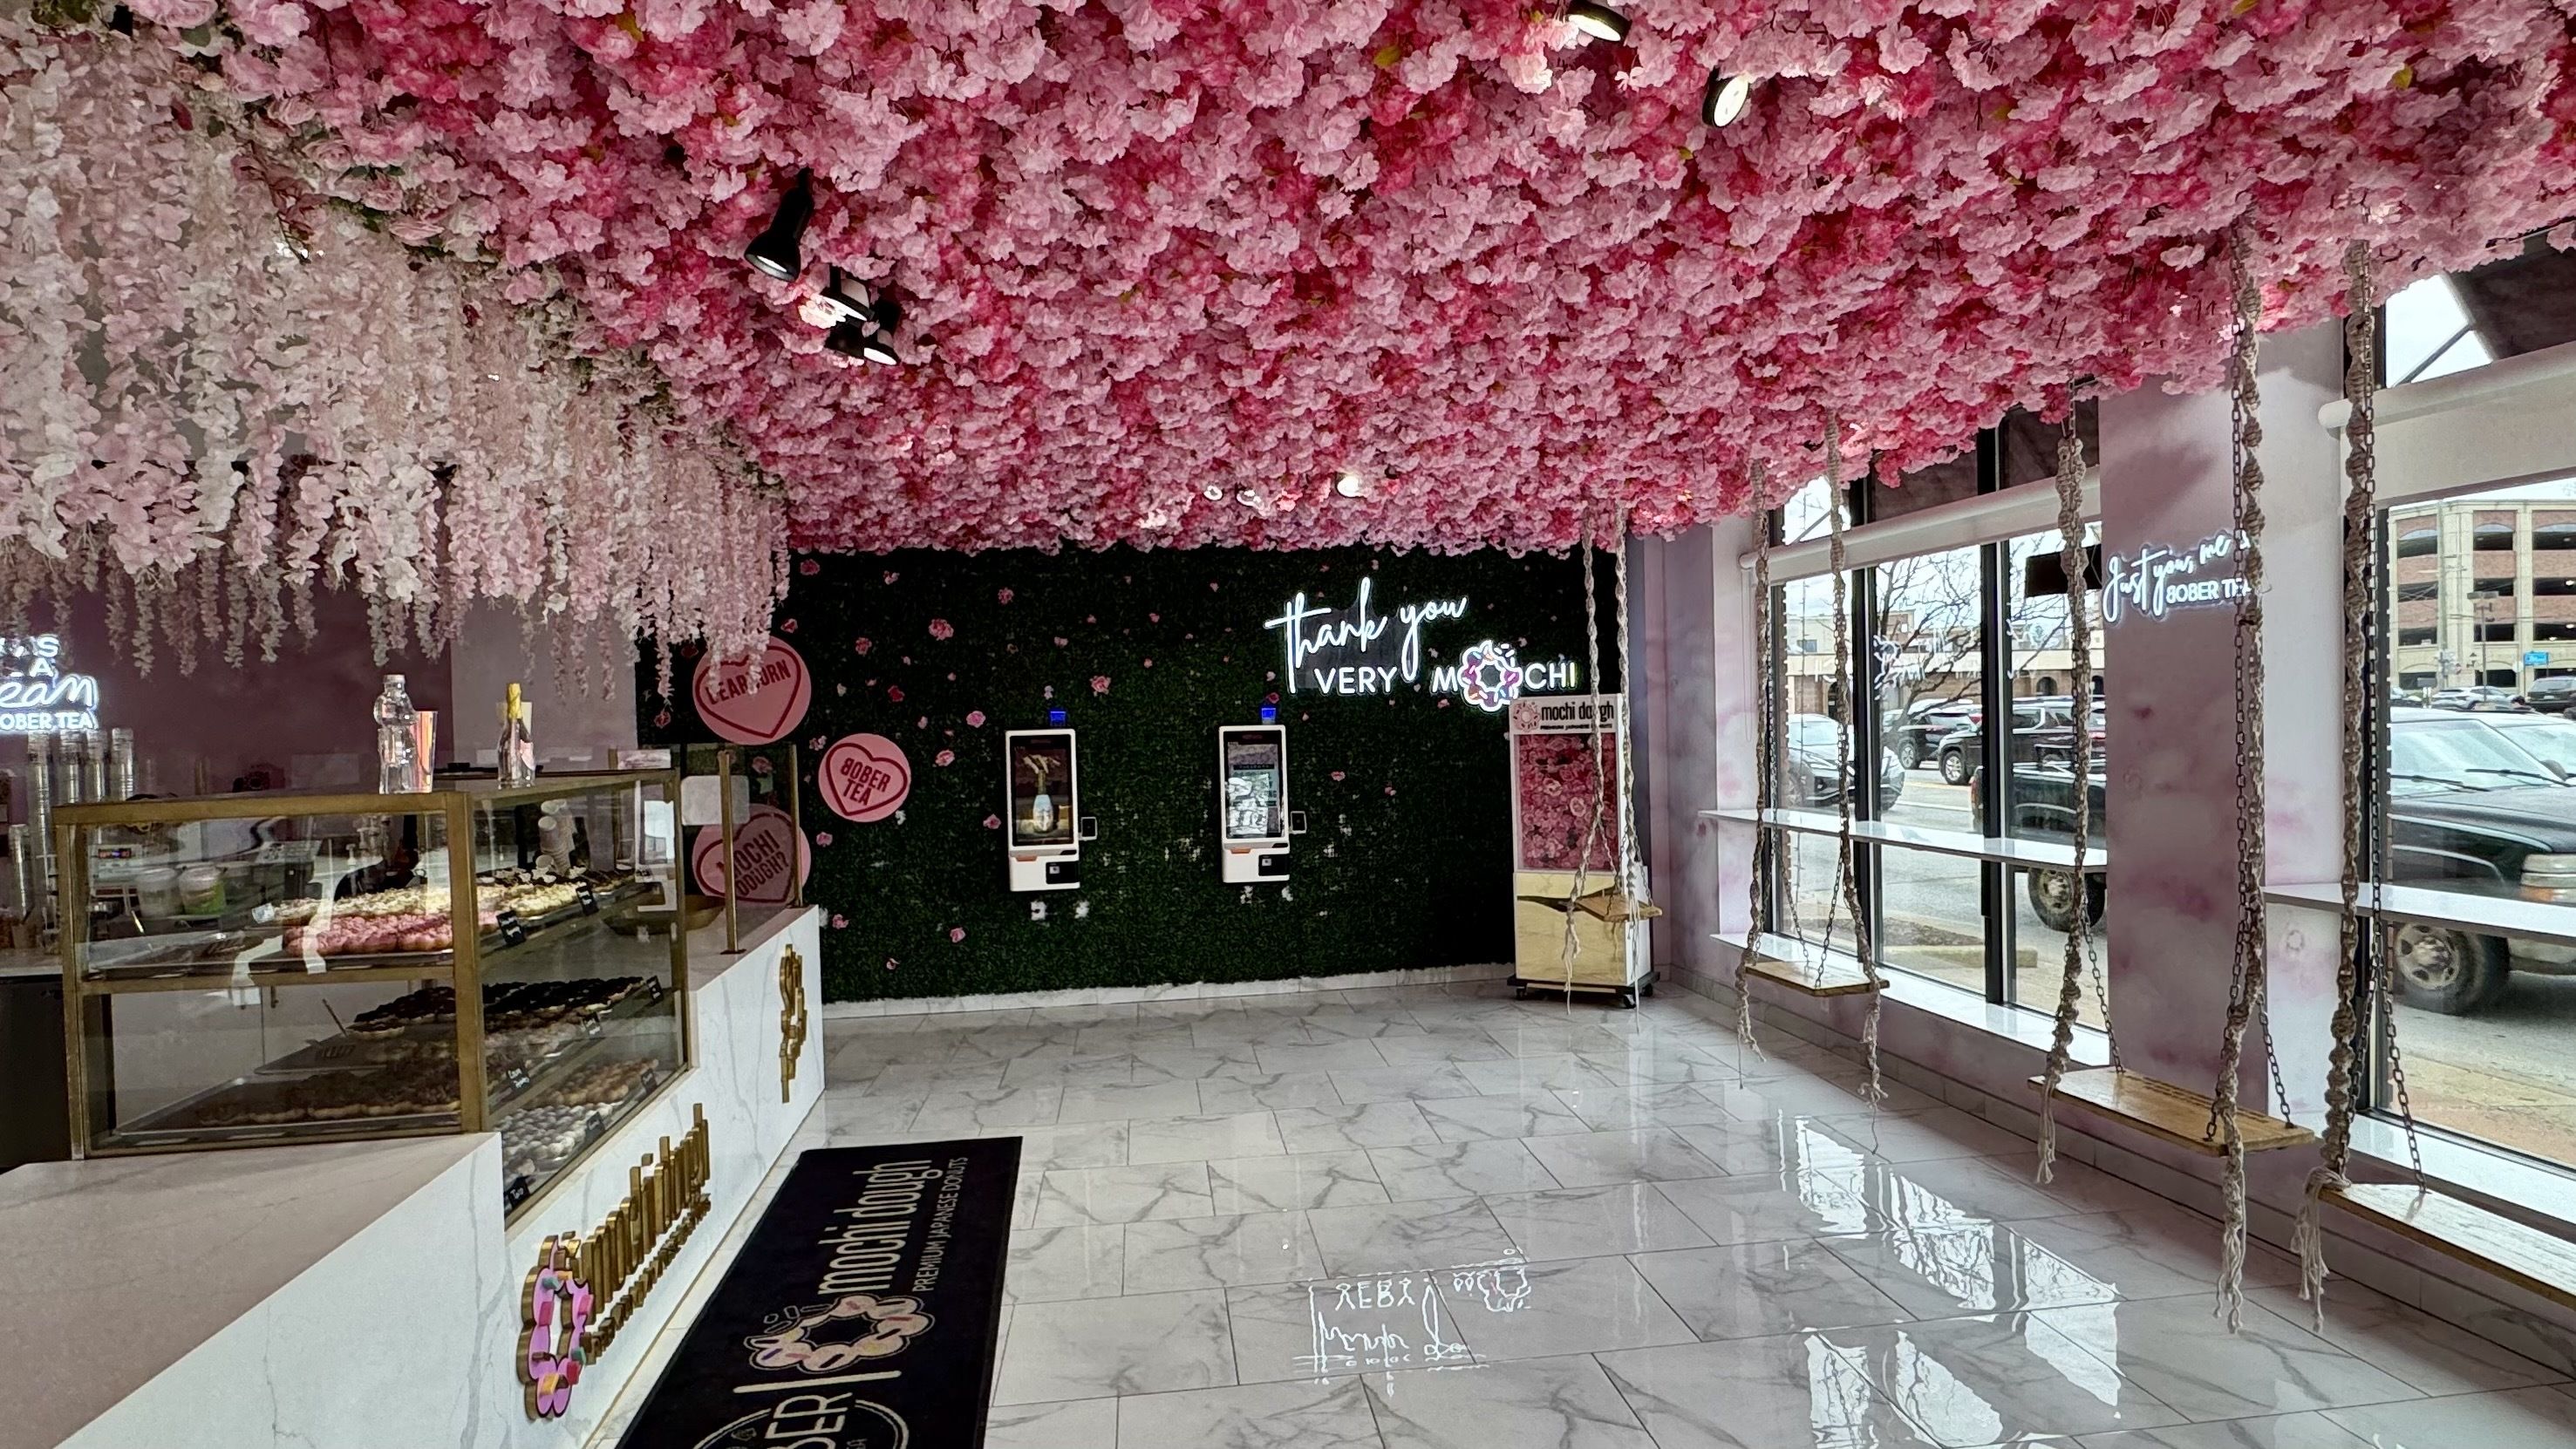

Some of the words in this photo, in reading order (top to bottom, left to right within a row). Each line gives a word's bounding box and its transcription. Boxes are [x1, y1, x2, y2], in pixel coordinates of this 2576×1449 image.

[2102, 548, 2168, 623] Just
[2198, 534, 2232, 565] me
[1264, 576, 1388, 694] thank
[1400, 596, 1469, 683] you
[1313, 665, 1397, 695] VERY
[54, 711, 94, 730] TEA
[1540, 701, 1576, 722] mochi
[1578, 701, 1614, 723] dogh
[842, 778, 873, 806] TEA
[833, 1160, 944, 1219] dough
[941, 1156, 969, 1192] DONUTS
[927, 1192, 959, 1239] JAPANESE
[817, 1220, 912, 1296] mochi
[912, 1240, 948, 1292] PREMIUM
